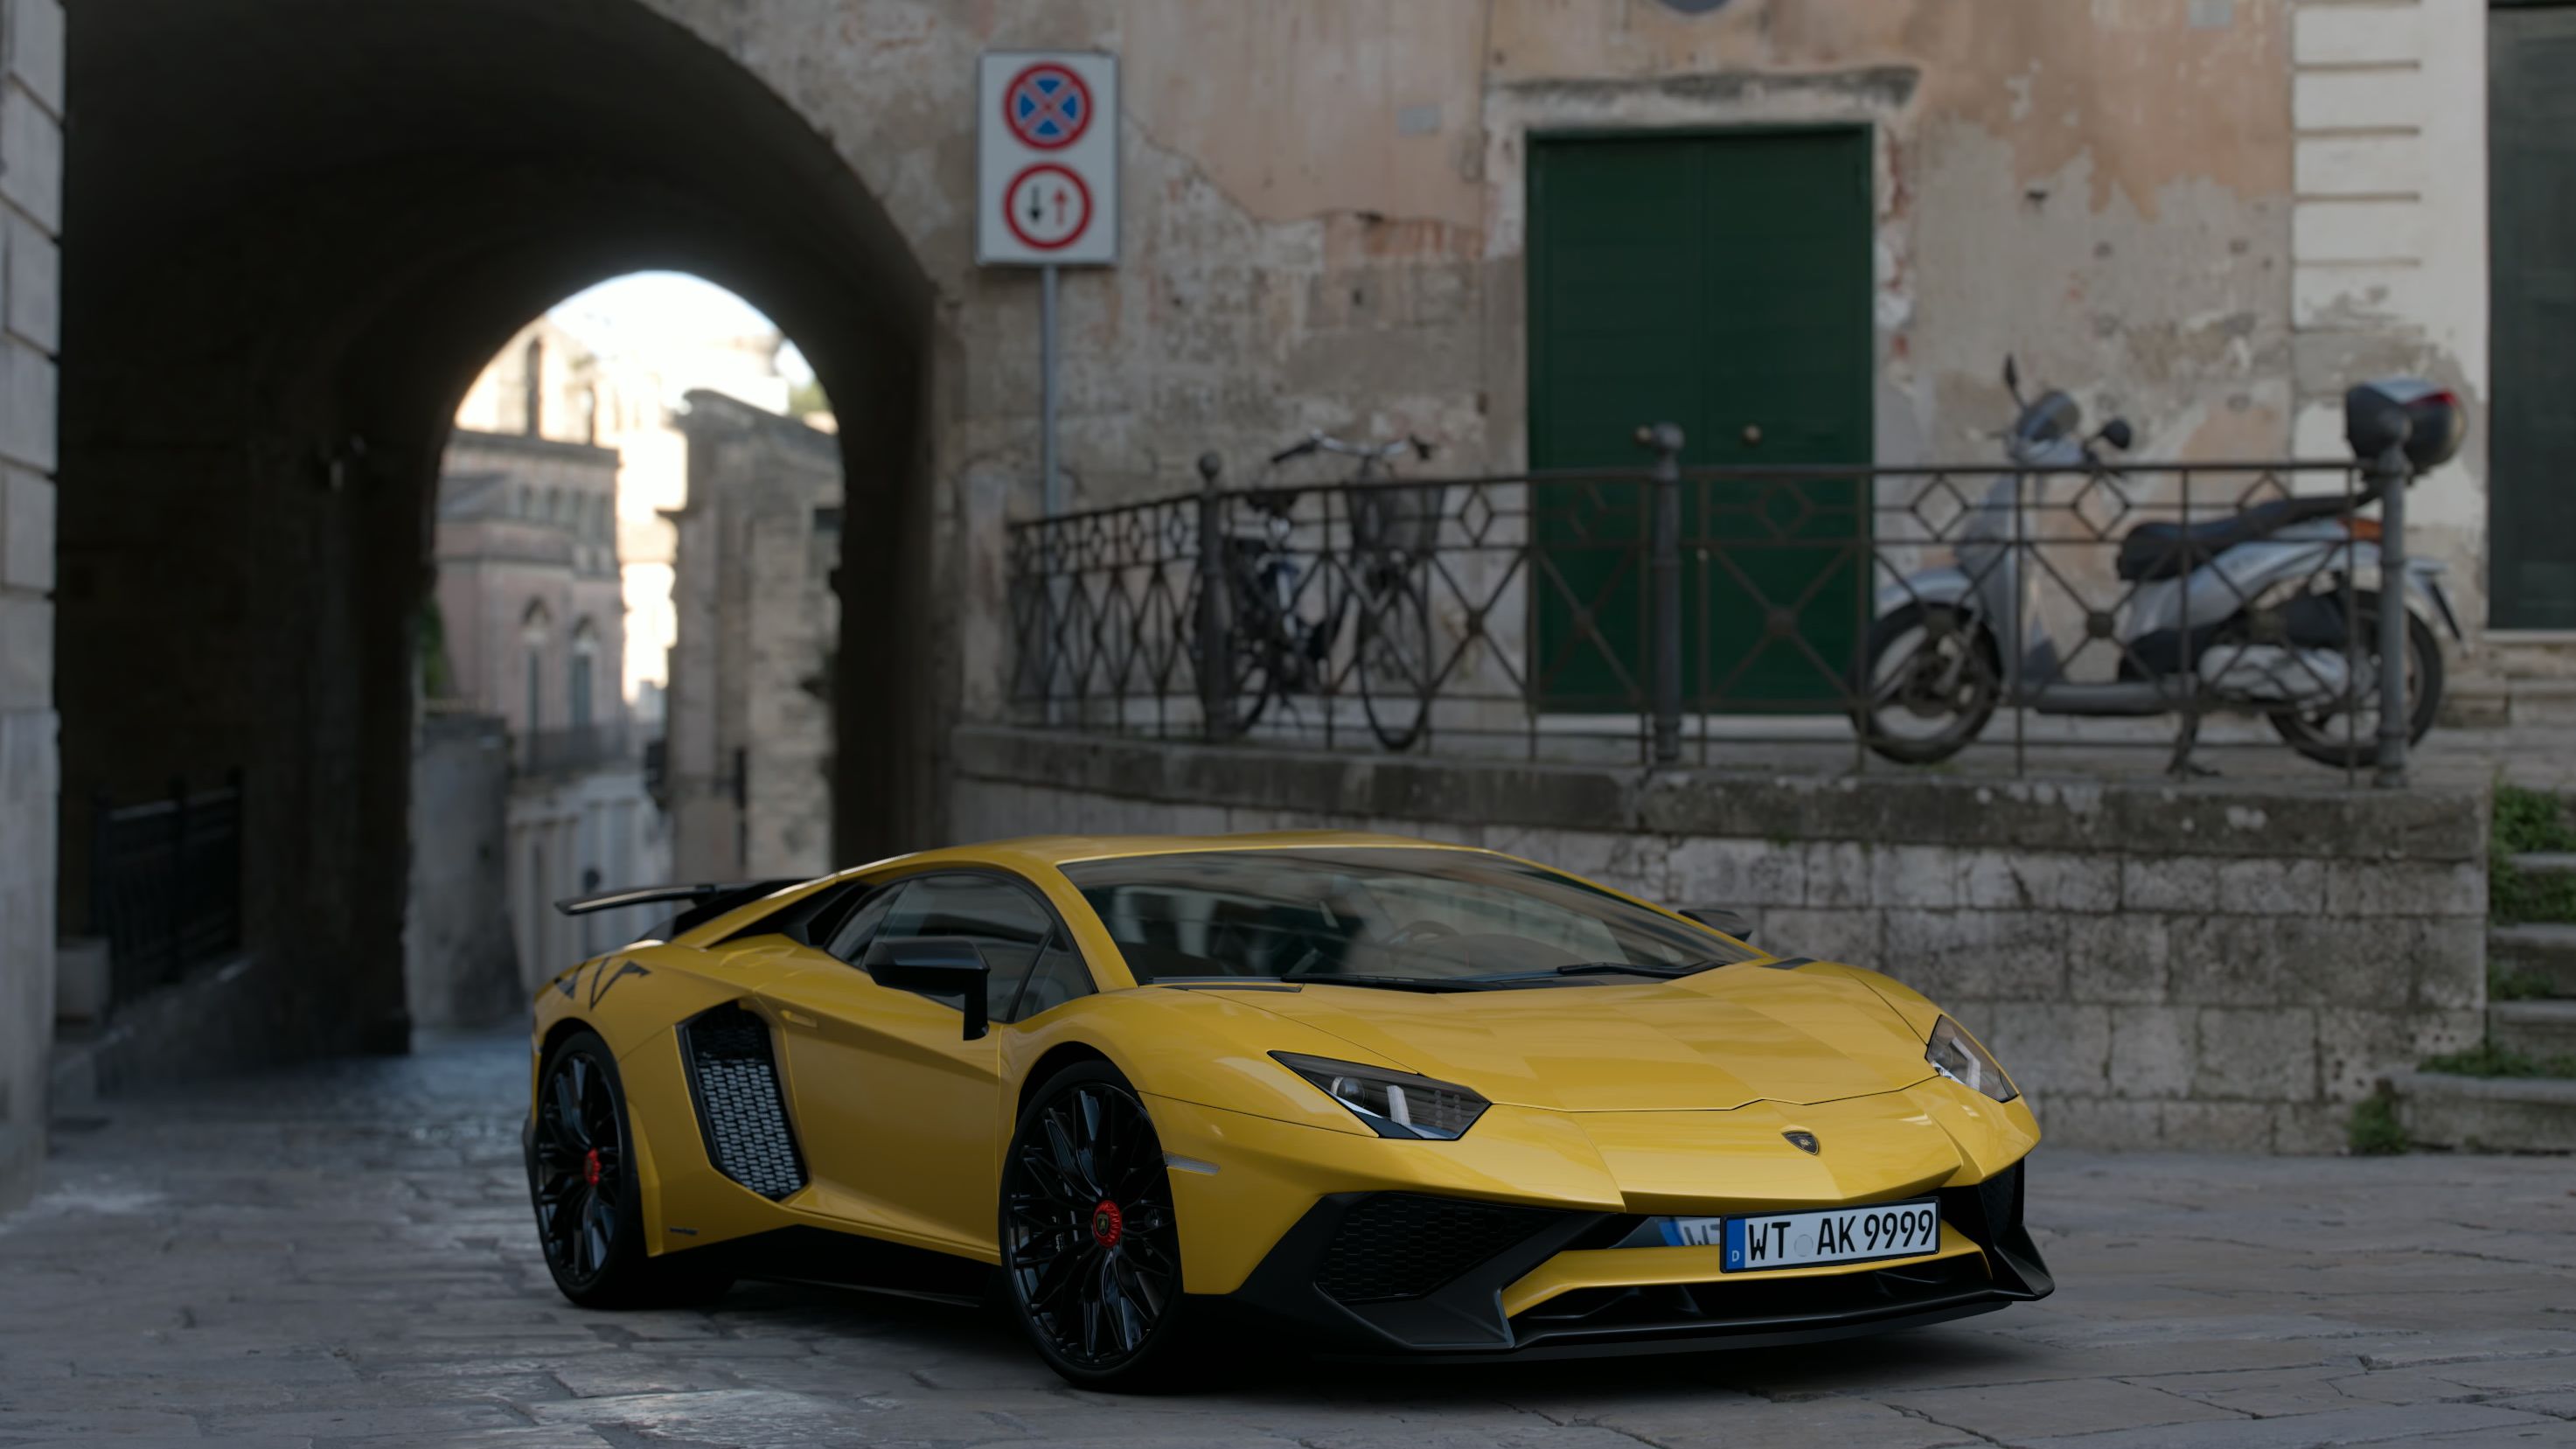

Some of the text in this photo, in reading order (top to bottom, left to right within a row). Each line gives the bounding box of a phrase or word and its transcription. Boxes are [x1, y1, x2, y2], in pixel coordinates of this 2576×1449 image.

[1749, 1209, 1933, 1261] WT AK 9999
[1731, 1250, 1739, 1262] D
